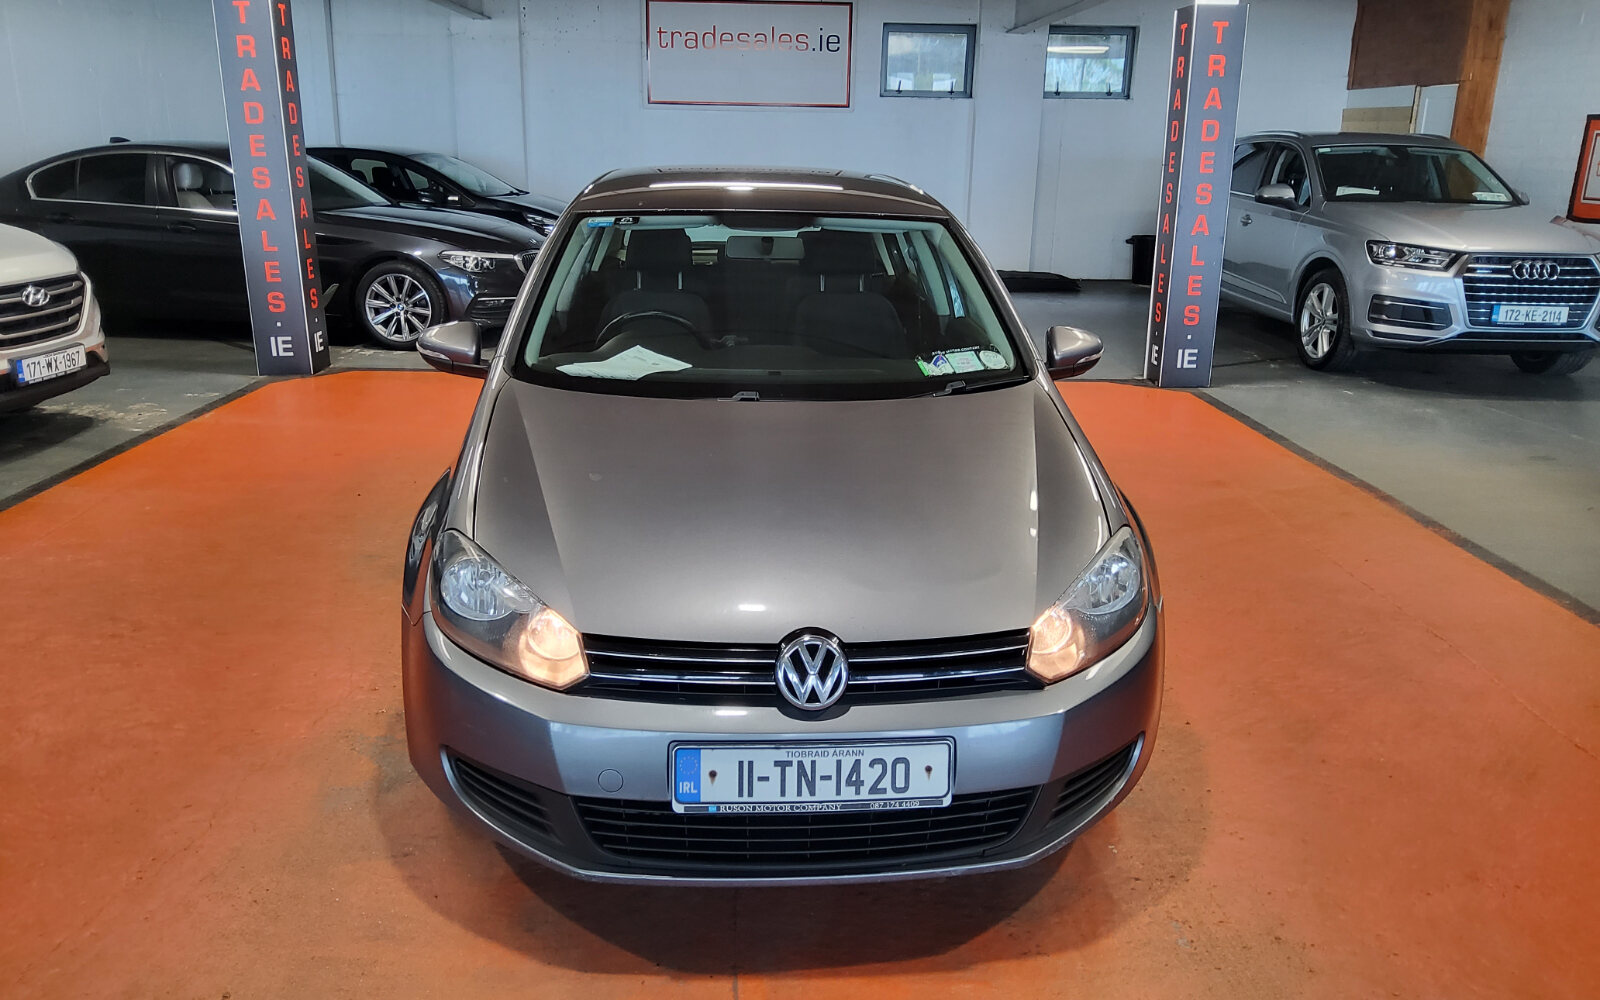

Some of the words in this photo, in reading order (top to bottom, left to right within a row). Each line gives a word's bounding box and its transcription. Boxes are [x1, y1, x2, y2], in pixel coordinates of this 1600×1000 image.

[657, 25, 841, 52] tradesales.ie
[1505, 309, 1562, 322] 172-KE-2114
[26, 351, 80, 378] 171-WX-1967
[786, 750, 829, 758] TIOBRAID
[737, 757, 911, 798] 11-TN-1420
[679, 782, 698, 794] IRL
[794, 803, 842, 811] COMPANY
